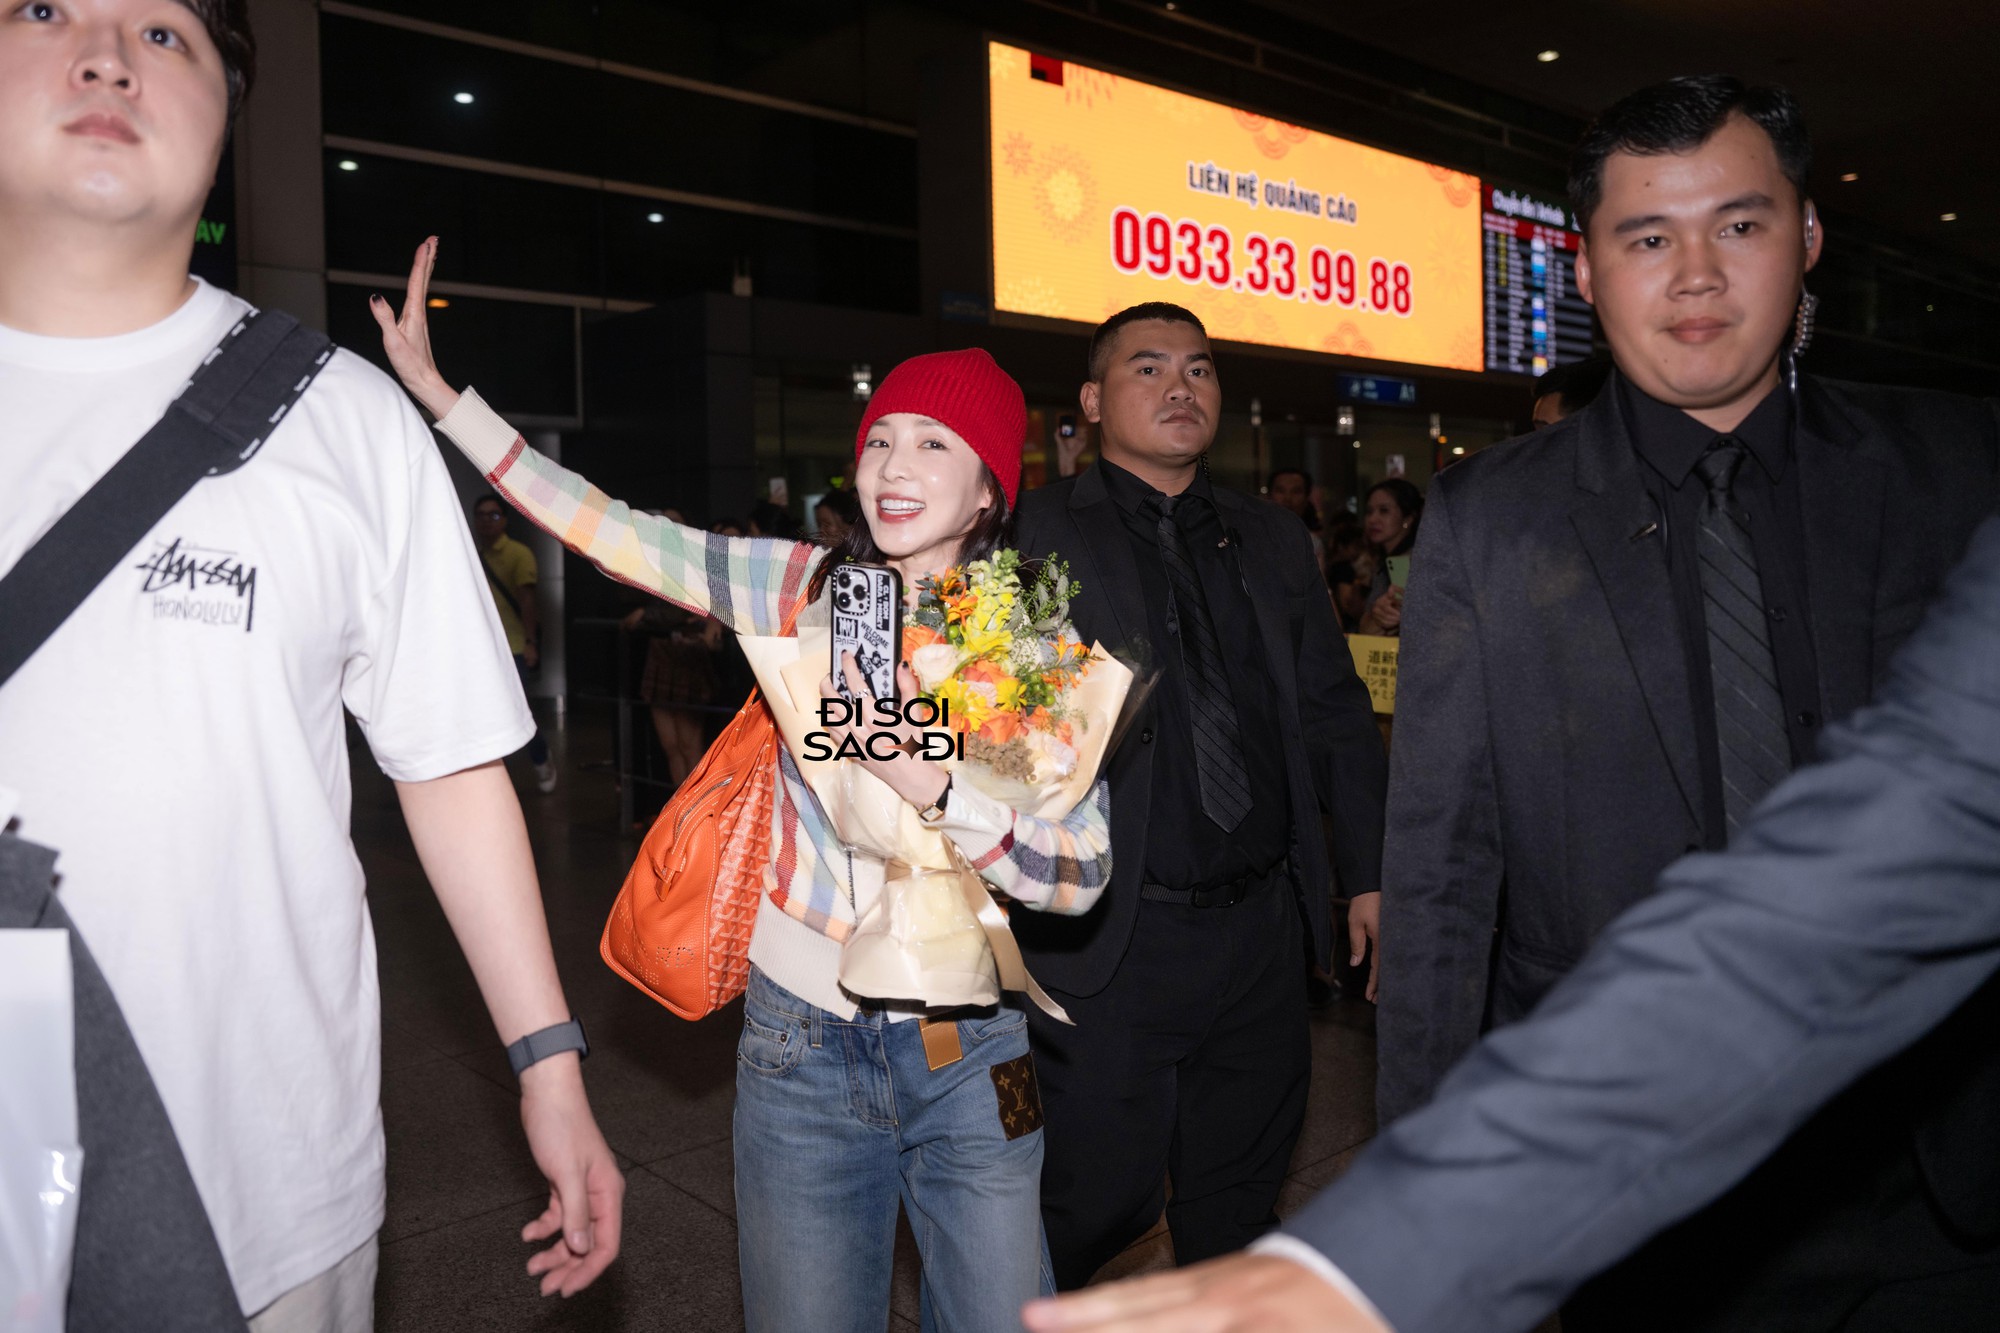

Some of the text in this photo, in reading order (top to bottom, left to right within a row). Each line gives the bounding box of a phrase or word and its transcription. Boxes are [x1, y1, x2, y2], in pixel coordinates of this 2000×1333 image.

[1188, 162, 1357, 223] LIÊN HỆ QUẢNG CÁO
[1113, 209, 1413, 316] 0933.33.99.88
[153, 595, 244, 626] HONOLULU
[861, 621, 889, 649] WELCOME
[864, 632, 880, 649] BACK
